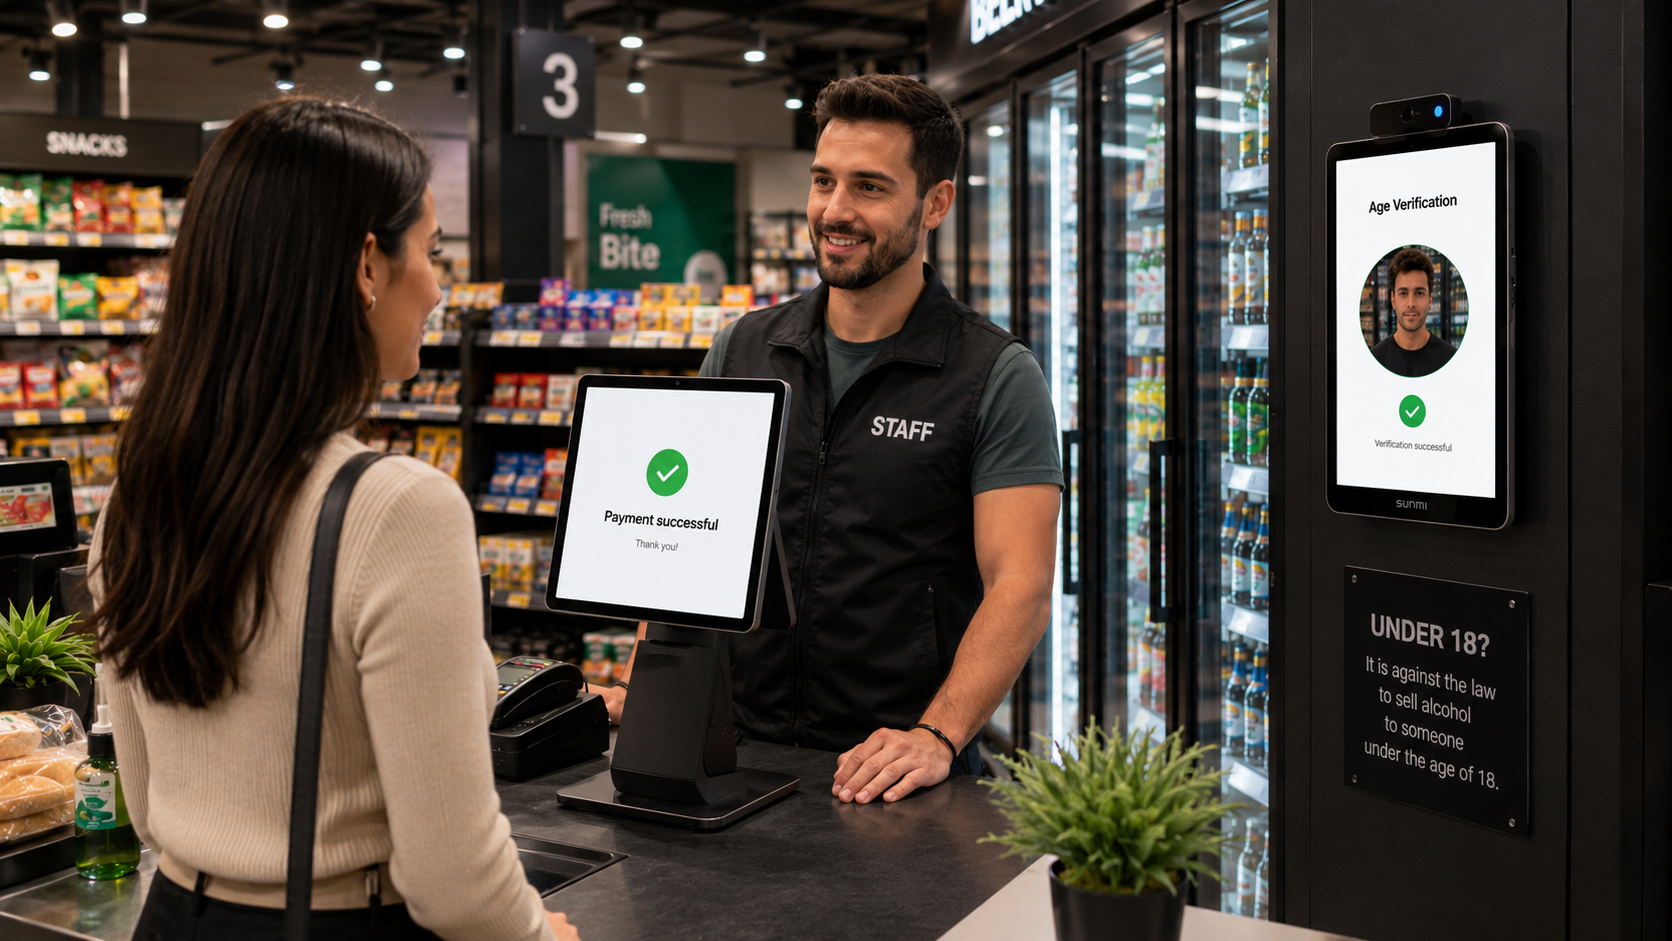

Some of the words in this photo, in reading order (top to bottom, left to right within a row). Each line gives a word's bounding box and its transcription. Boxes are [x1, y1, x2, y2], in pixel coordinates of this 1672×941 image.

[542, 53, 579, 119] 3
[46, 130, 128, 158] SNACKS
[599, 202, 653, 230] Fresh
[1368, 200, 1391, 216] Age
[1392, 194, 1458, 211] Verification
[600, 233, 661, 271] Bite
[870, 415, 935, 442] STAFF
[1374, 439, 1413, 450] Verification
[1413, 441, 1453, 453] successful
[604, 510, 655, 526] Payment
[656, 517, 719, 531] successful
[635, 538, 660, 550] Thank
[660, 542, 679, 553] you!
[1370, 612, 1445, 649] UNDER
[1450, 628, 1490, 658] 18?
[1366, 655, 1375, 673] It
[1377, 657, 1389, 676] is
[1391, 664, 1441, 689] against
[1443, 672, 1467, 694] the
[1471, 678, 1497, 701] law
[1378, 686, 1392, 704] to
[1395, 692, 1418, 711] sell
[1421, 696, 1471, 724] alcohol
[1384, 715, 1398, 733] to
[1401, 722, 1464, 751] someone
[1364, 740, 1401, 762] under
[1404, 748, 1426, 769] the
[1429, 759, 1455, 779] age
[1459, 765, 1475, 783] of
[1478, 769, 1500, 791] 18.
